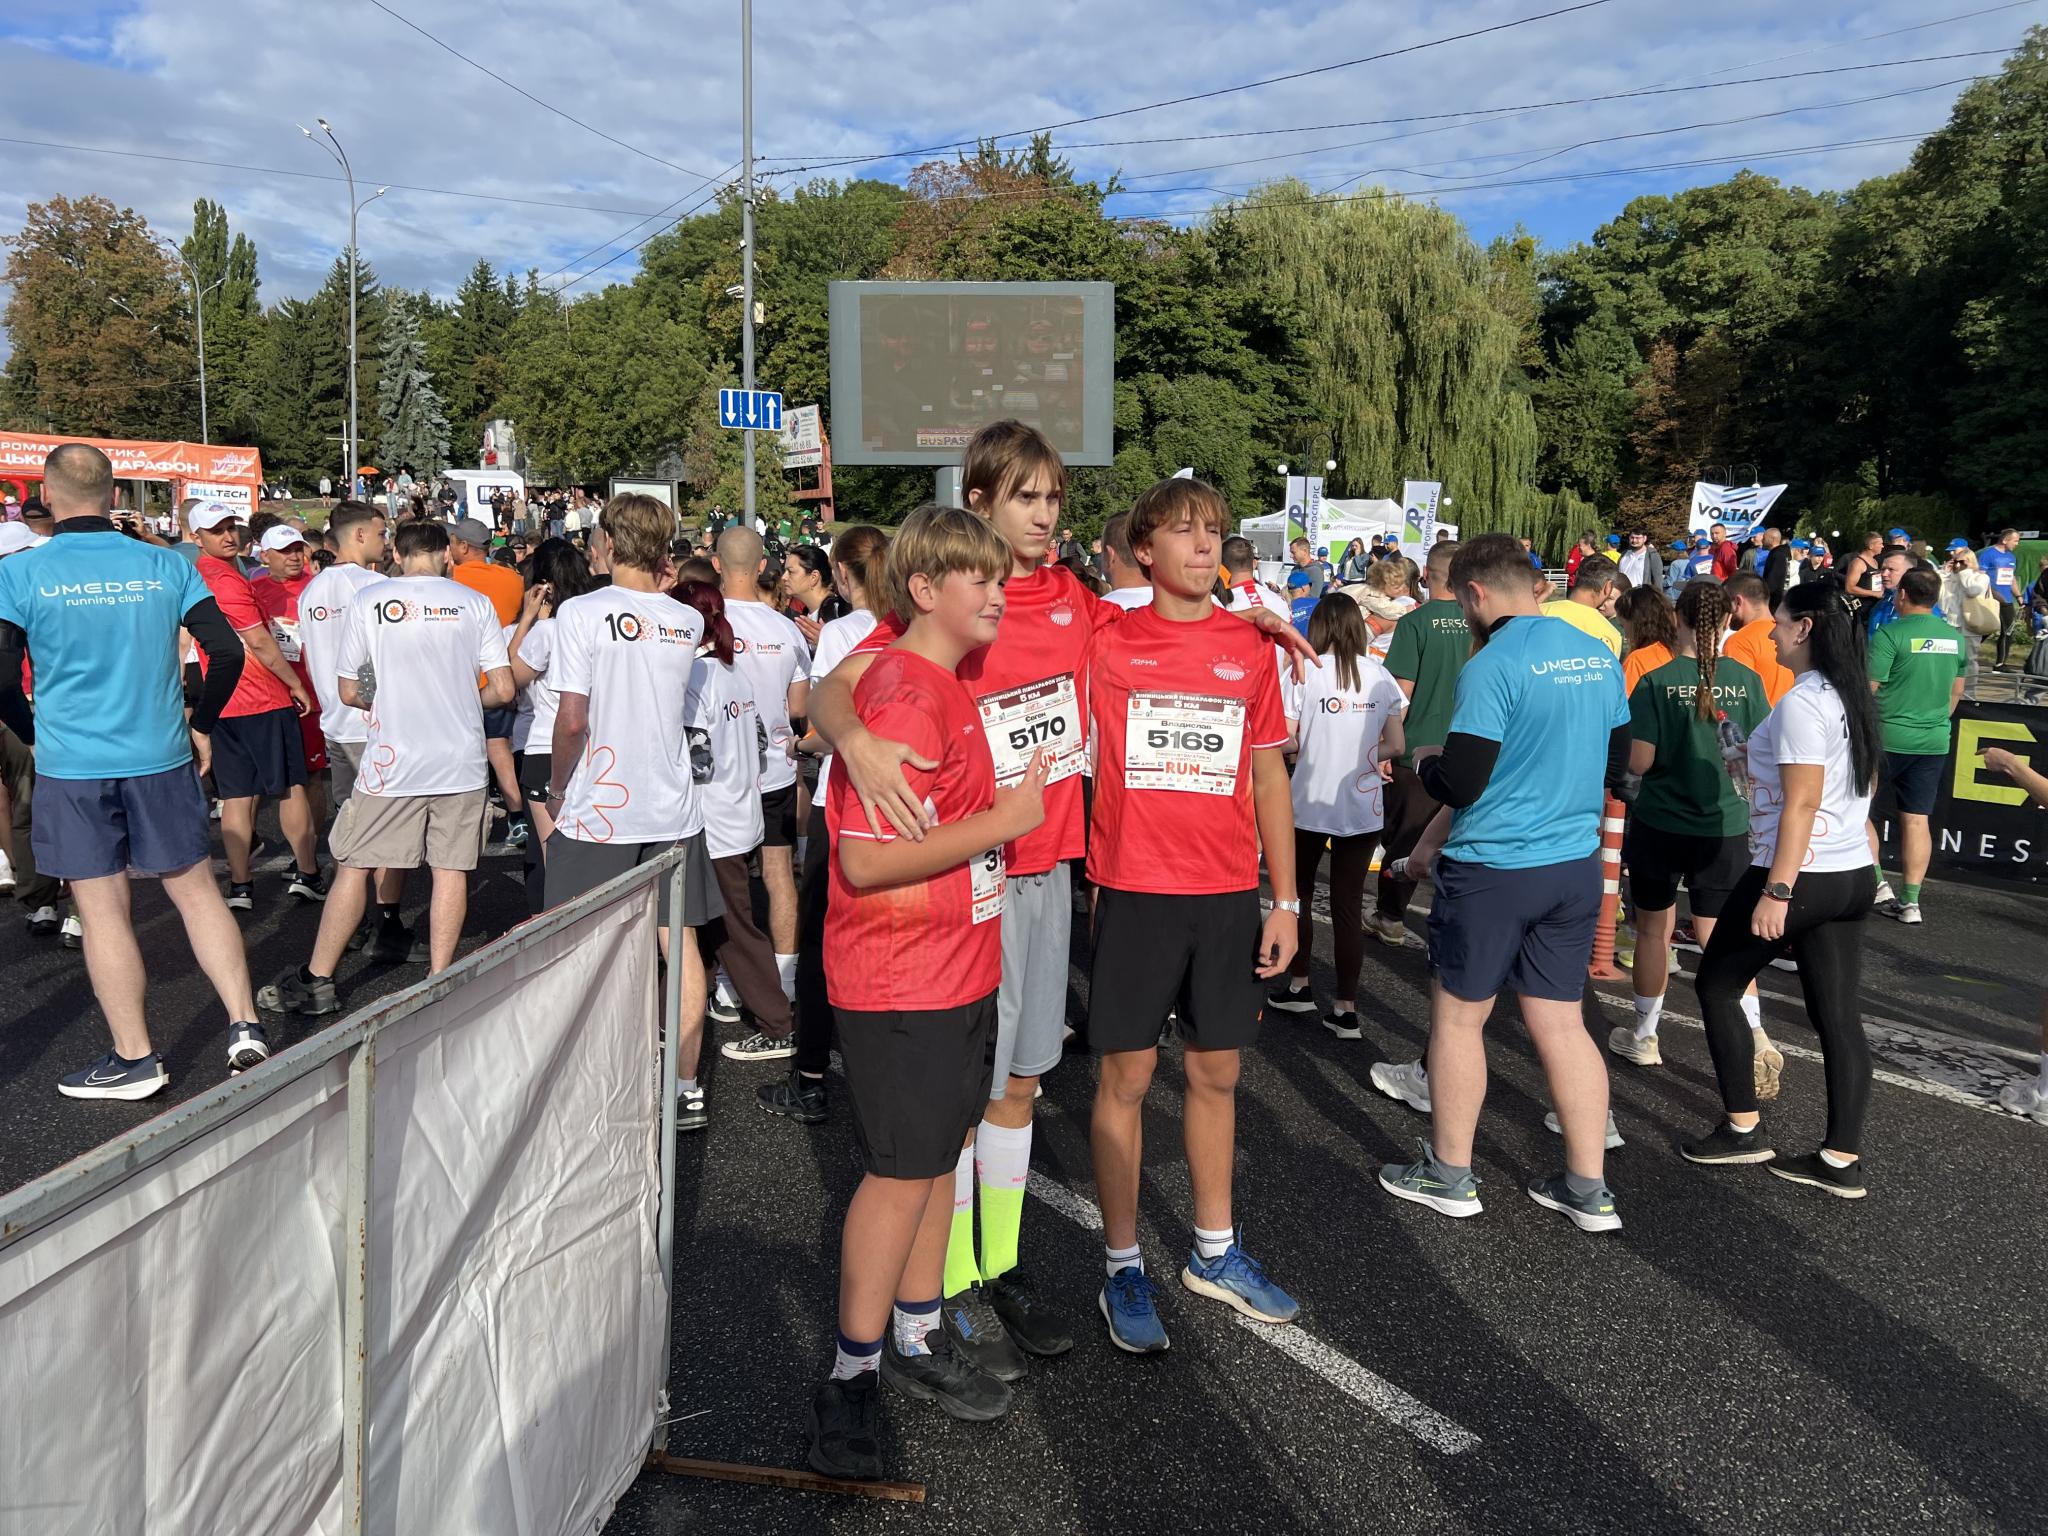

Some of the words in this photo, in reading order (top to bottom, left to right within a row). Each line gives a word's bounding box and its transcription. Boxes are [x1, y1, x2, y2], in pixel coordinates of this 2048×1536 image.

[190, 487, 248, 499] BILLTECH
[1424, 489, 1438, 556] АГРОПРОСПЕРІС
[40, 580, 163, 598] UMEDEX
[66, 595, 115, 606] running
[118, 594, 144, 603] club
[1531, 656, 1612, 675] UMEDEX
[1583, 672, 1603, 682] club
[1020, 694, 1028, 702] 5
[1161, 720, 1212, 730] Владислав
[1009, 716, 1066, 750] 5170
[1147, 730, 1224, 753] 5169
[1039, 752, 1057, 769] UN
[1165, 762, 1200, 776] RUN
